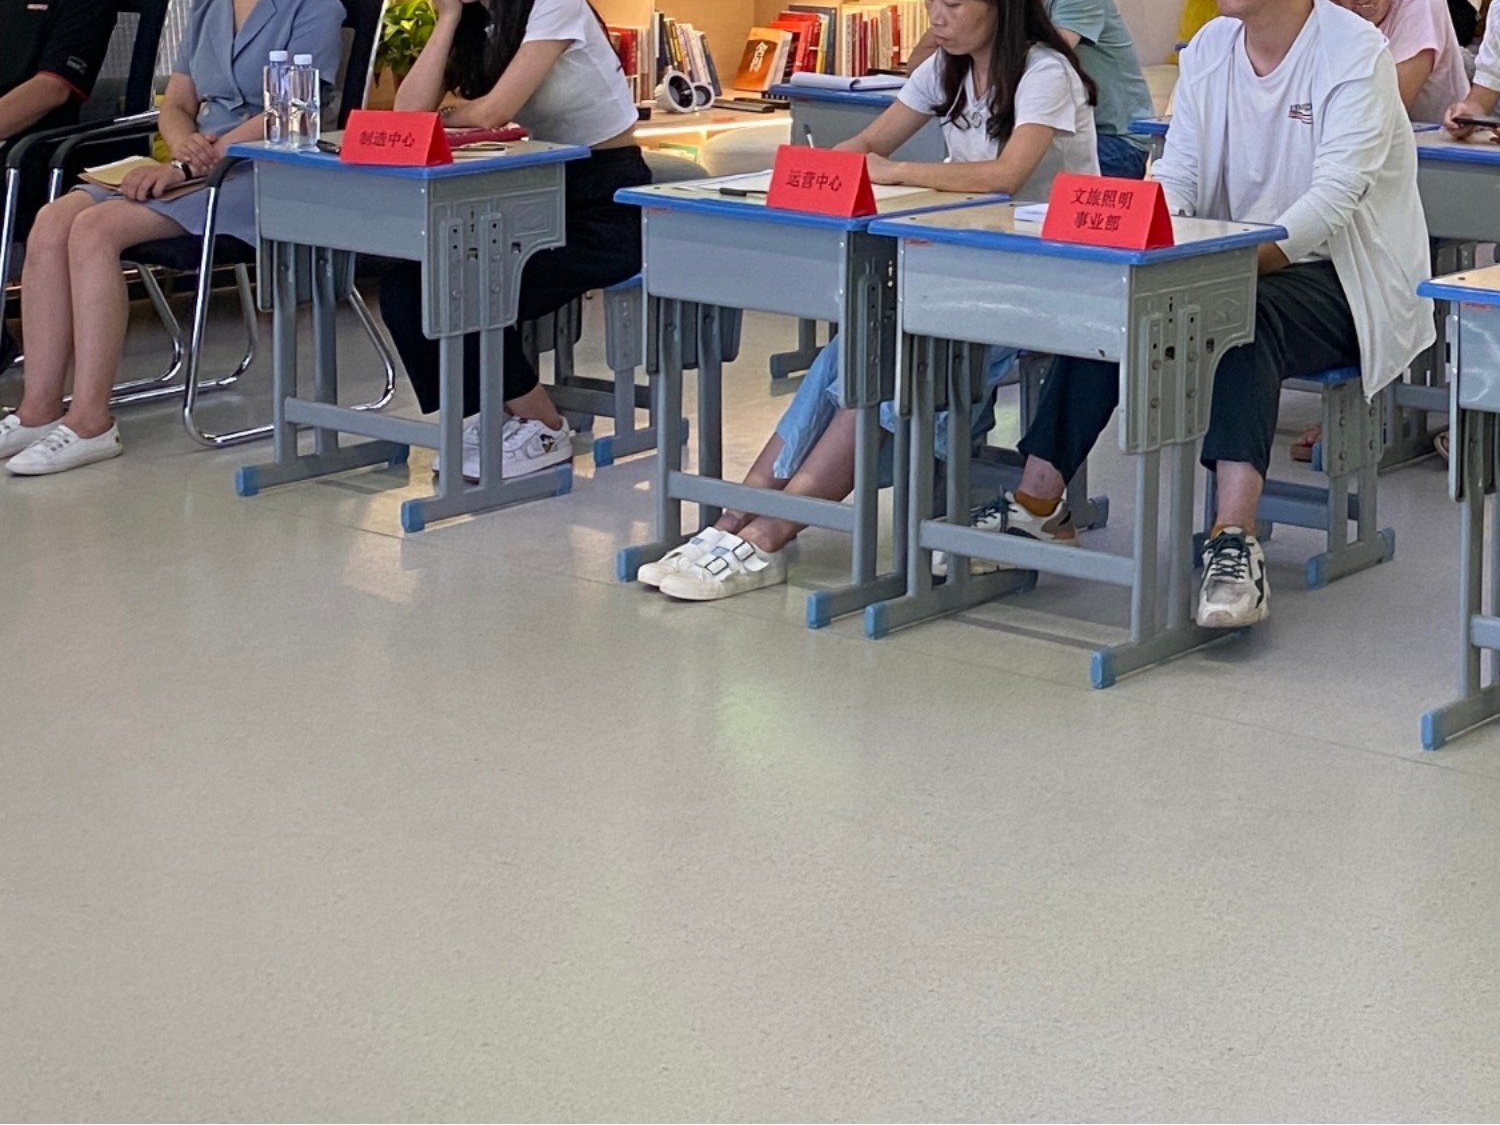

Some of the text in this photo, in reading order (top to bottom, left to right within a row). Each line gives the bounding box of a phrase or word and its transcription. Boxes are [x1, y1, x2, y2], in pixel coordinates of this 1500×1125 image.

[359, 130, 415, 148] 制造中心
[786, 170, 842, 192] 运营中心
[1070, 187, 1133, 210] 文旅照明
[1074, 211, 1121, 232] 事业部
